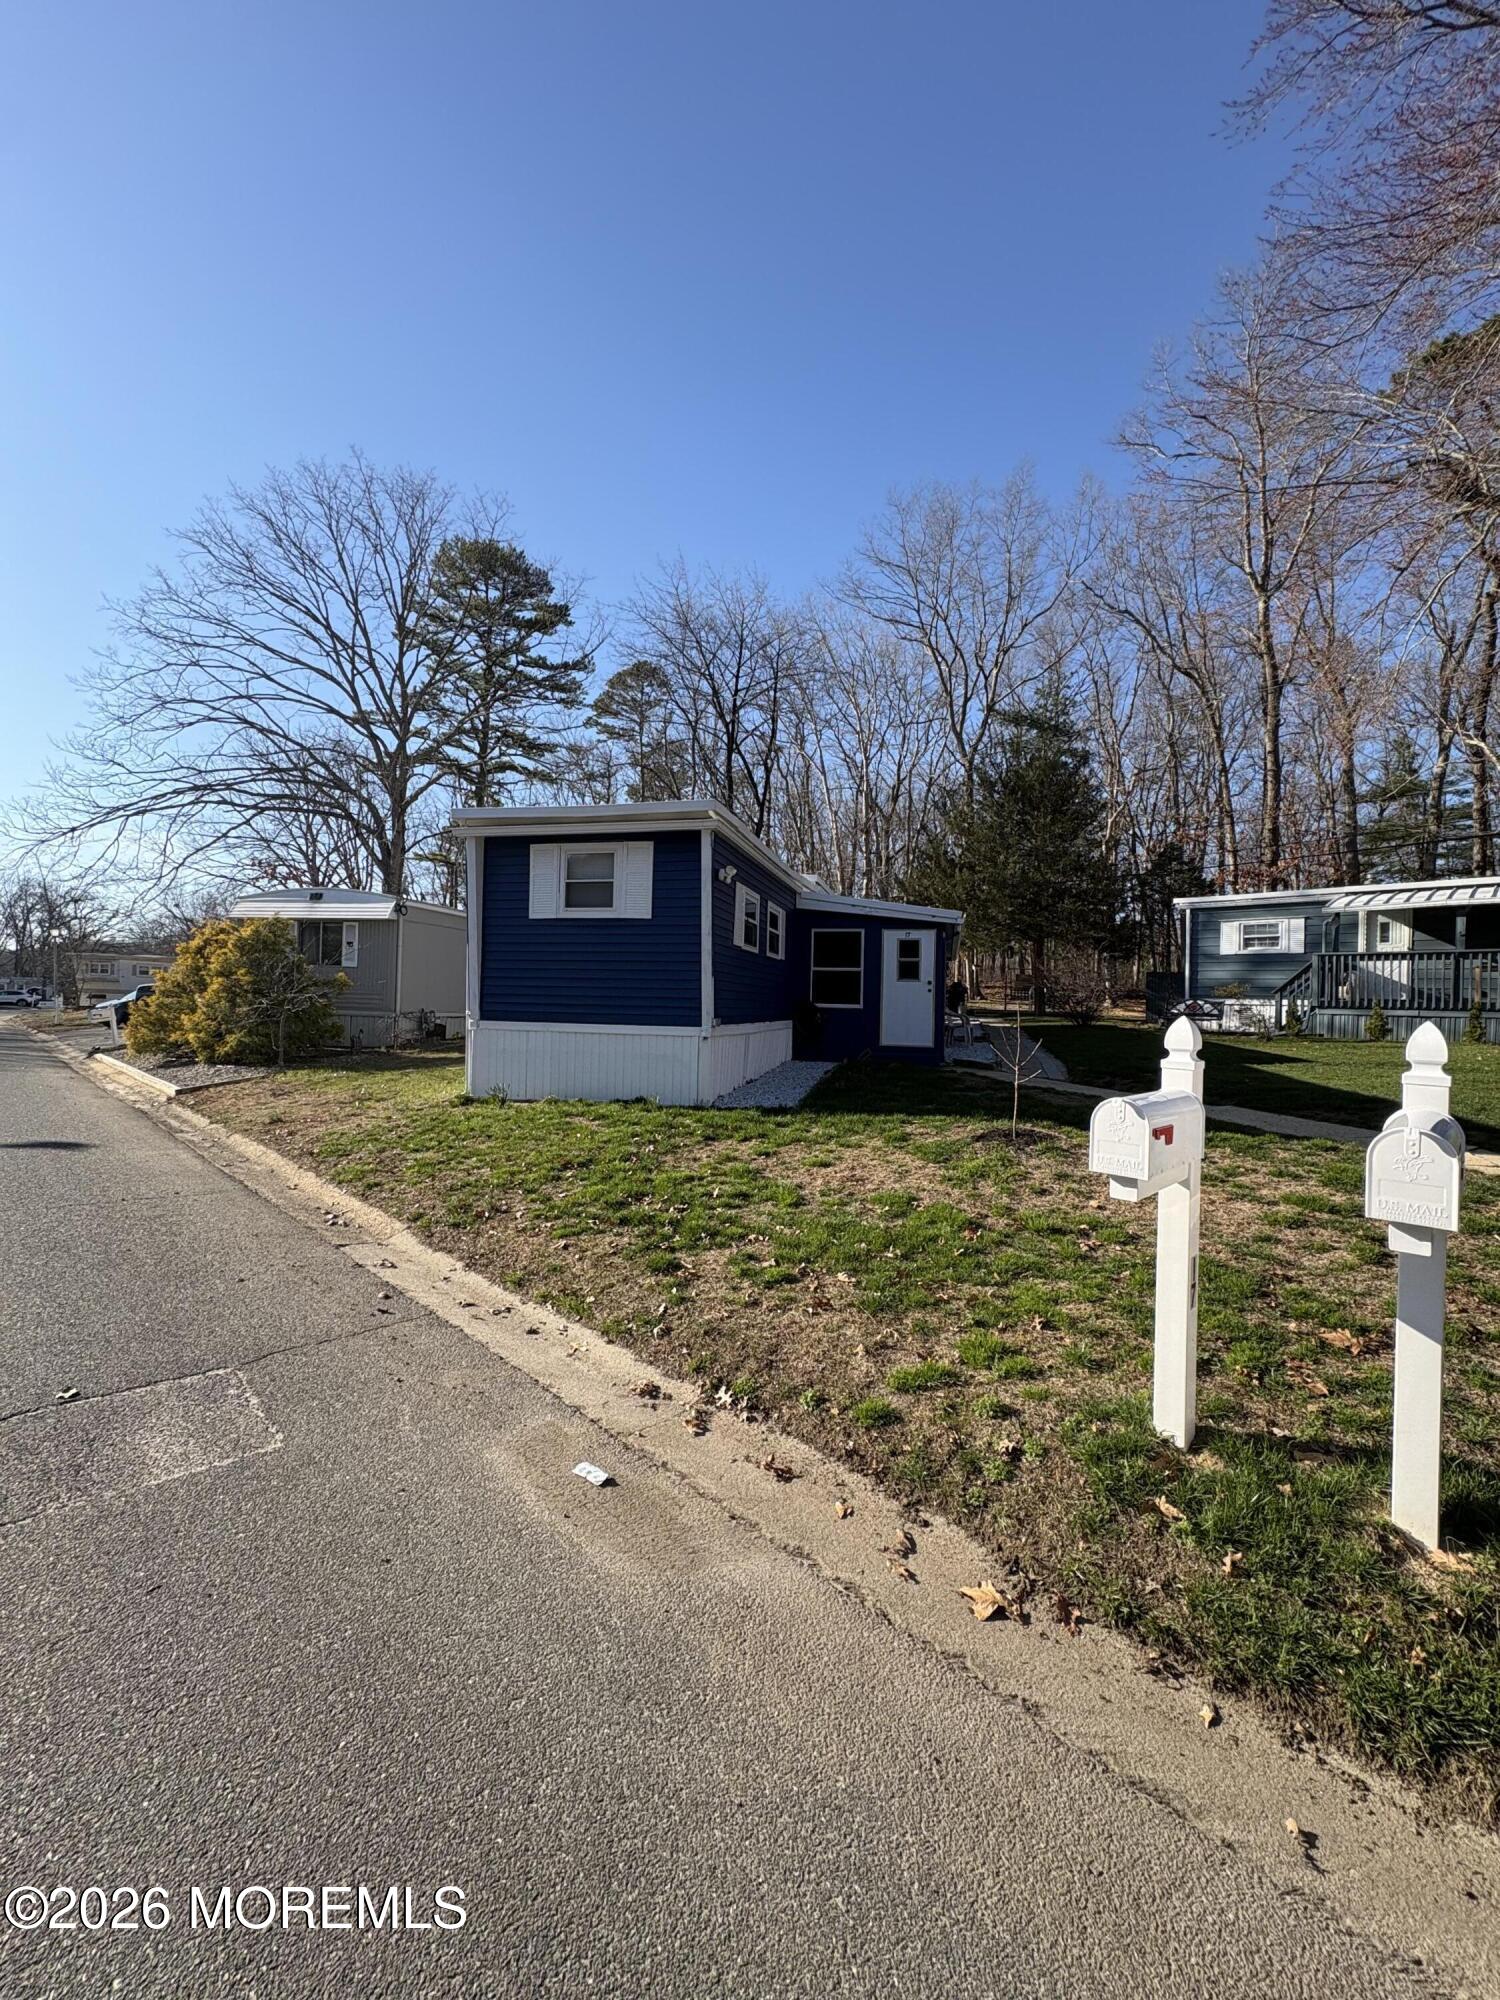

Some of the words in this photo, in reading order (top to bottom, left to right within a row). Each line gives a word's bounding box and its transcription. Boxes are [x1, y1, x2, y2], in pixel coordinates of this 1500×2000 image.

[1116, 1158, 1145, 1171] MAIL
[1377, 1198, 1404, 1213] U.S.
[1407, 1202, 1449, 1219] MAIL
